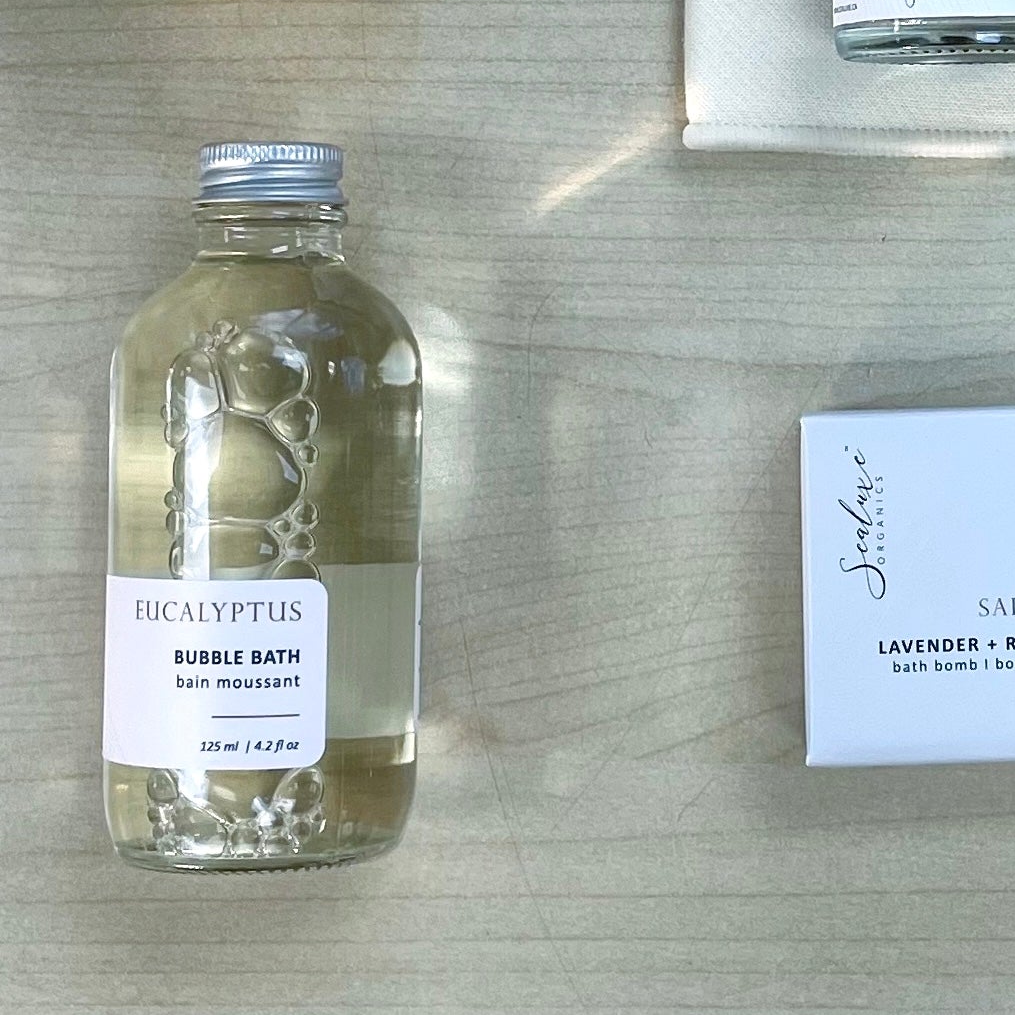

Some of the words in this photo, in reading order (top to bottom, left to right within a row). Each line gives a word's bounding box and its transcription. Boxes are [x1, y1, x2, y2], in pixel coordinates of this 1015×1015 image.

[877, 476, 885, 564] ORGANICS
[136, 600, 301, 622] EUCALYPTUS
[879, 638, 979, 654] LAVENDER
[988, 640, 997, 650] +
[175, 650, 243, 665] BUBBLE
[252, 649, 300, 664] BATH
[893, 660, 927, 673] bath
[935, 658, 977, 671] bomb
[177, 674, 209, 688] bain
[217, 675, 300, 689] moussant
[201, 741, 221, 751] 125
[224, 741, 239, 751] ml
[254, 741, 272, 751] 4.2
[274, 740, 284, 753] fl
[287, 742, 299, 750] oz
